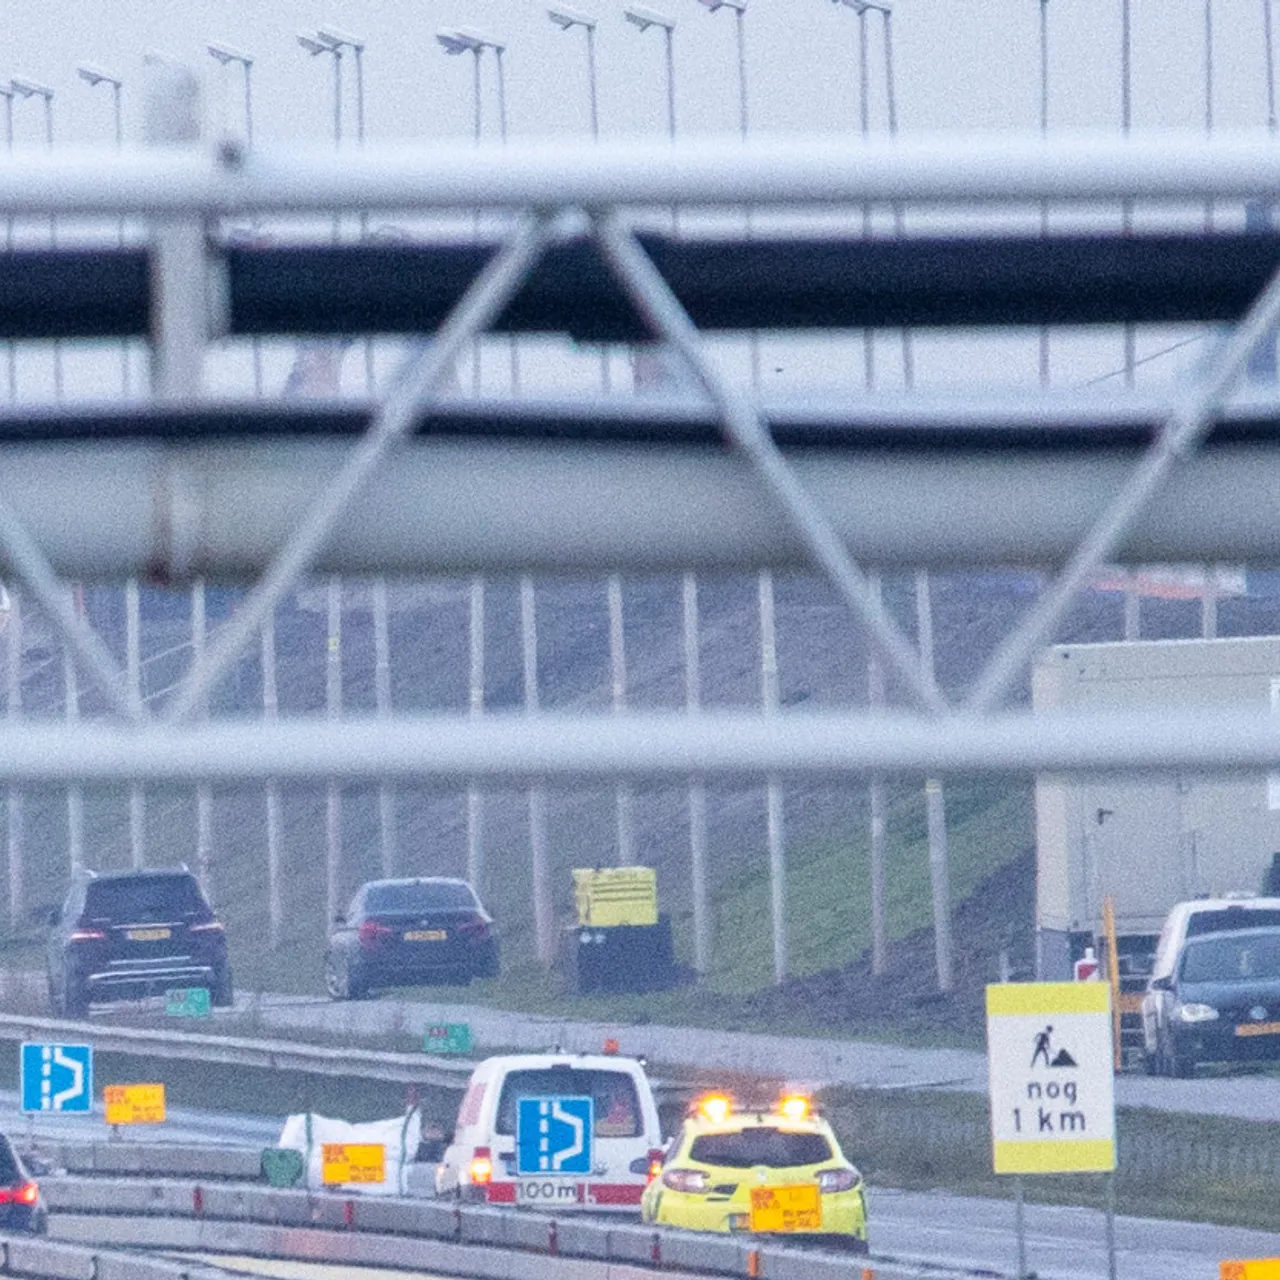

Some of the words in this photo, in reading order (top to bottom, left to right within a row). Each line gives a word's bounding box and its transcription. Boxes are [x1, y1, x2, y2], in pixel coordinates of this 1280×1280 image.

[1027, 1082, 1078, 1106] nog
[1013, 1107, 1022, 1132] 1
[1038, 1106, 1086, 1132] km
